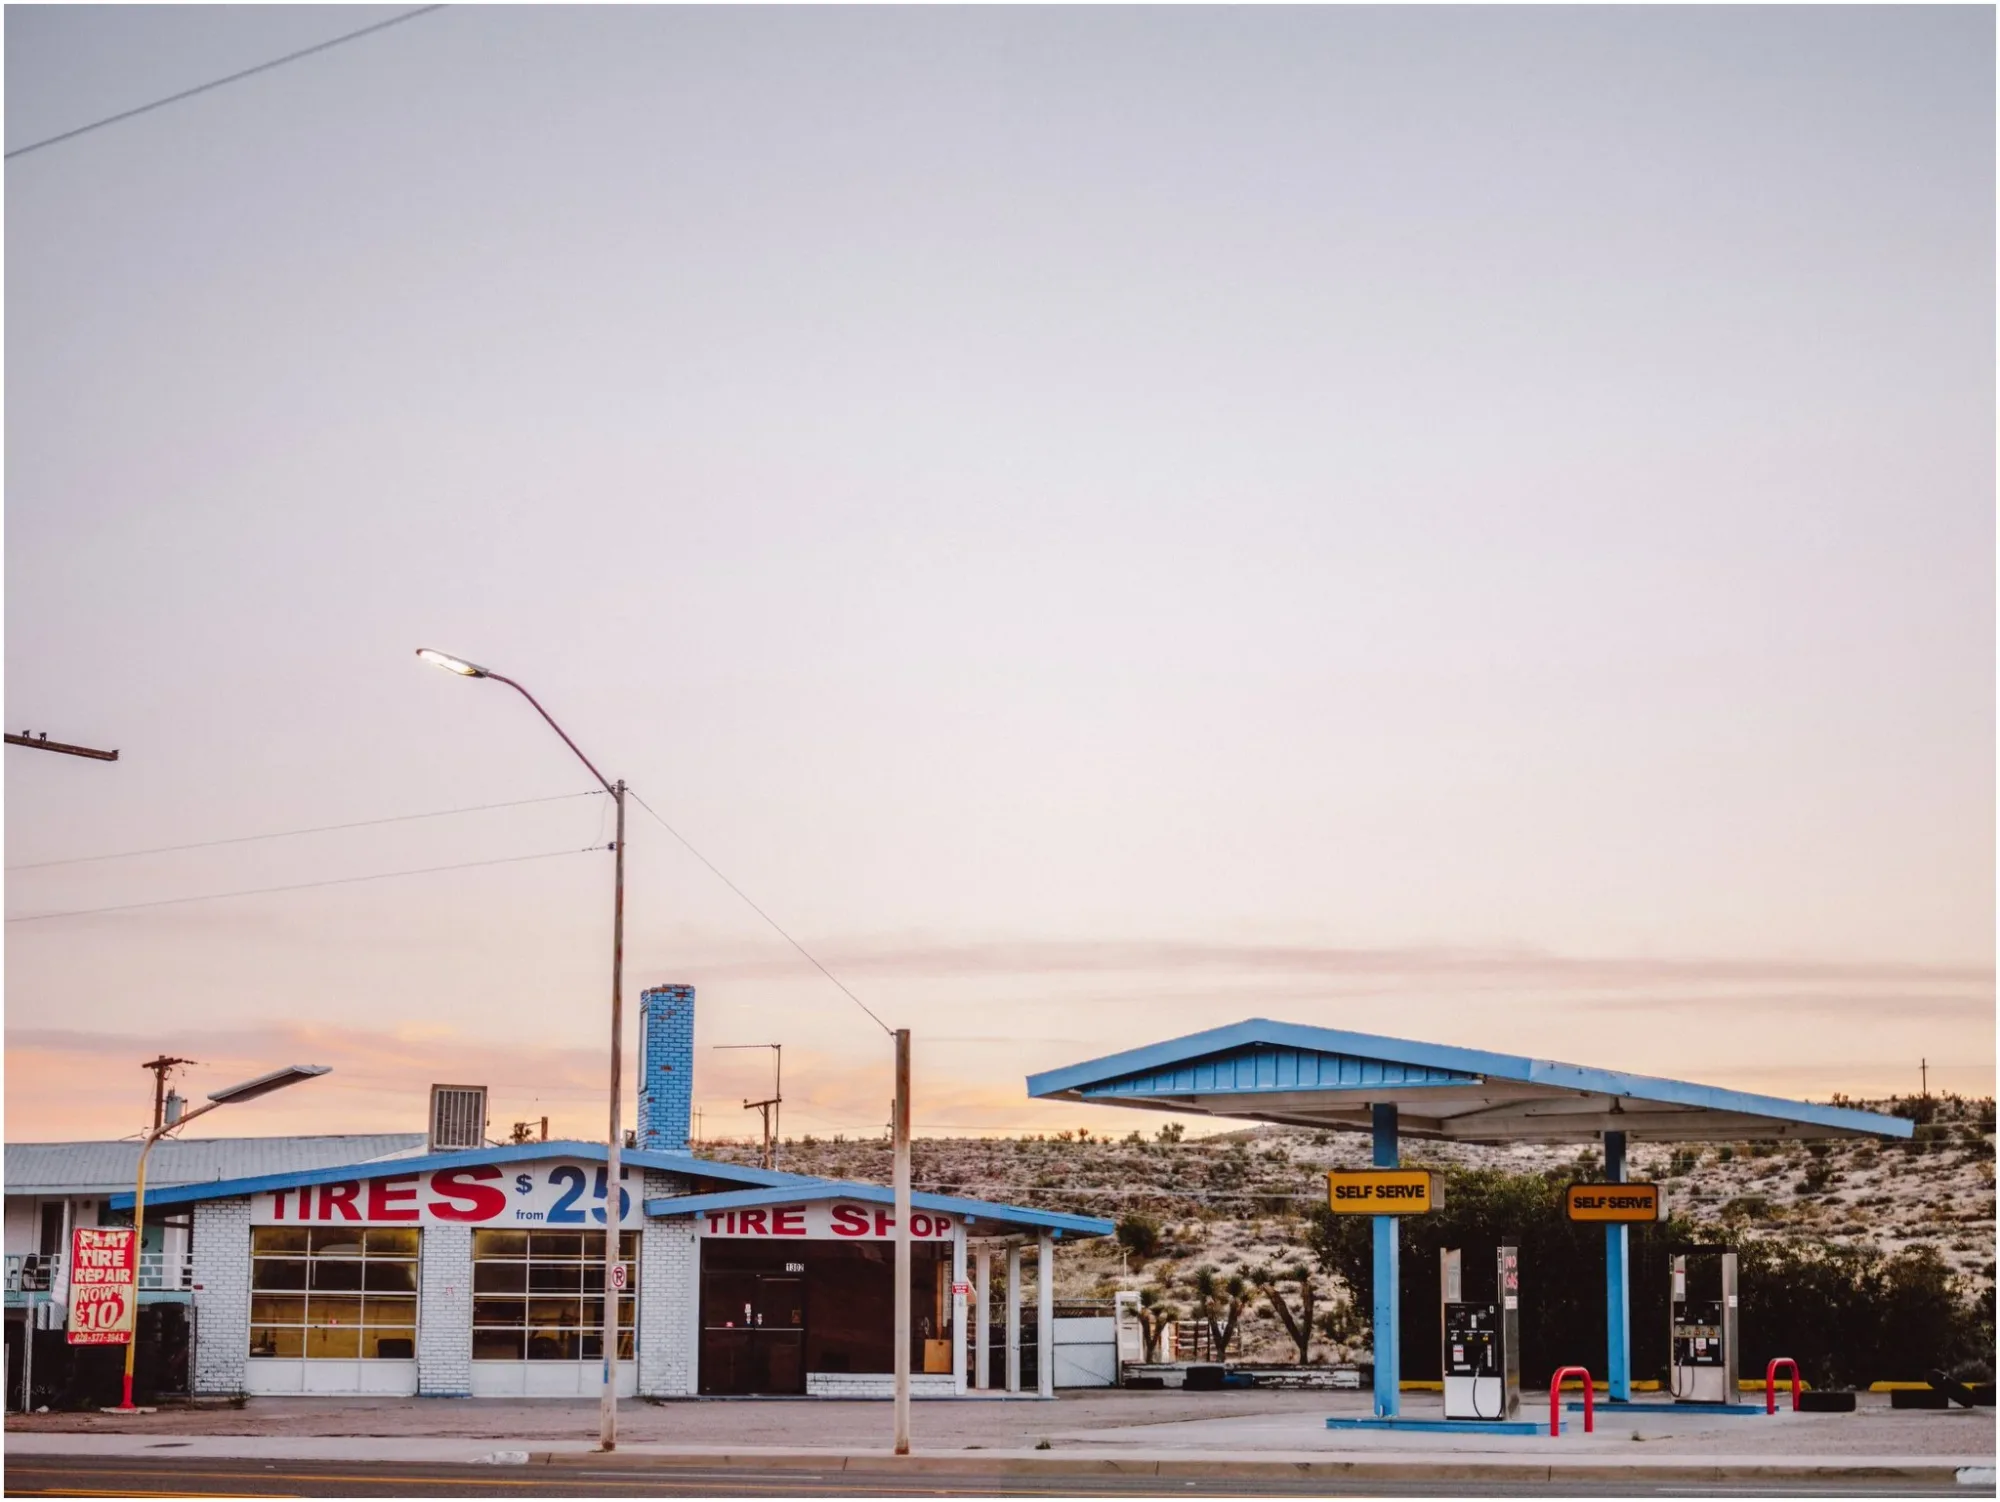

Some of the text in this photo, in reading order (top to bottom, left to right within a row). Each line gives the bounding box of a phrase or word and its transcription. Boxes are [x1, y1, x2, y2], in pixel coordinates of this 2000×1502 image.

[266, 1164, 506, 1222] TIRES
[546, 1165, 630, 1224] 25
[1335, 1184, 1425, 1199] SELF SERVE
[1573, 1196, 1652, 1209] SELF SERVE
[516, 1210, 543, 1220] from
[705, 1205, 806, 1235] TIRE
[79, 1230, 130, 1248] FLAT
[80, 1249, 125, 1267] TIRE
[74, 1268, 131, 1283] REPAIR
[76, 1301, 119, 1330] $10
